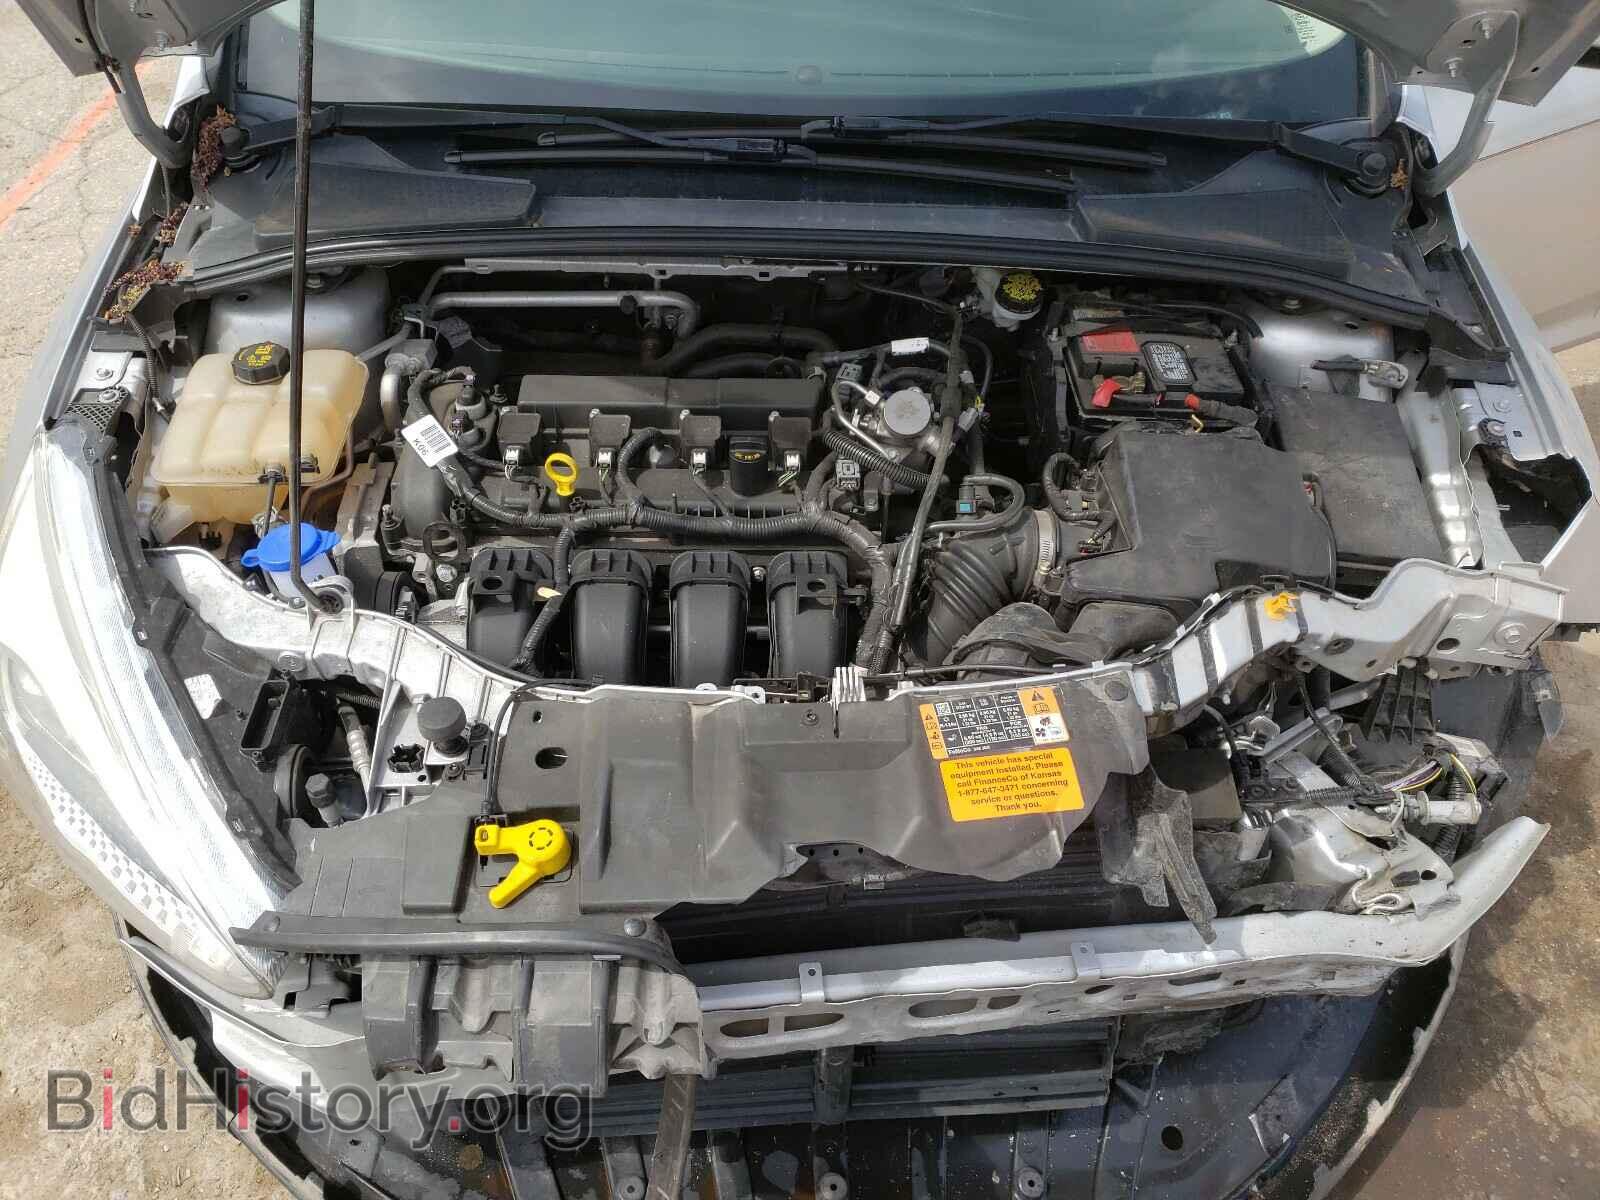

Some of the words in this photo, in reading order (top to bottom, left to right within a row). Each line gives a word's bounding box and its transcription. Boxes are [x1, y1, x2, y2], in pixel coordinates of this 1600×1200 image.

[956, 761, 973, 769] This
[976, 758, 1004, 767] vehicle
[1006, 756, 1021, 764] has
[1024, 752, 1053, 763] special
[950, 768, 994, 779] equipment
[1035, 761, 1064, 769] Please
[957, 779, 972, 788] call
[1020, 773, 1028, 781] of
[1031, 771, 1062, 780] Kansas
[1022, 778, 1068, 789] concerning
[971, 795, 1001, 805] service
[996, 803, 1021, 812] Thank
